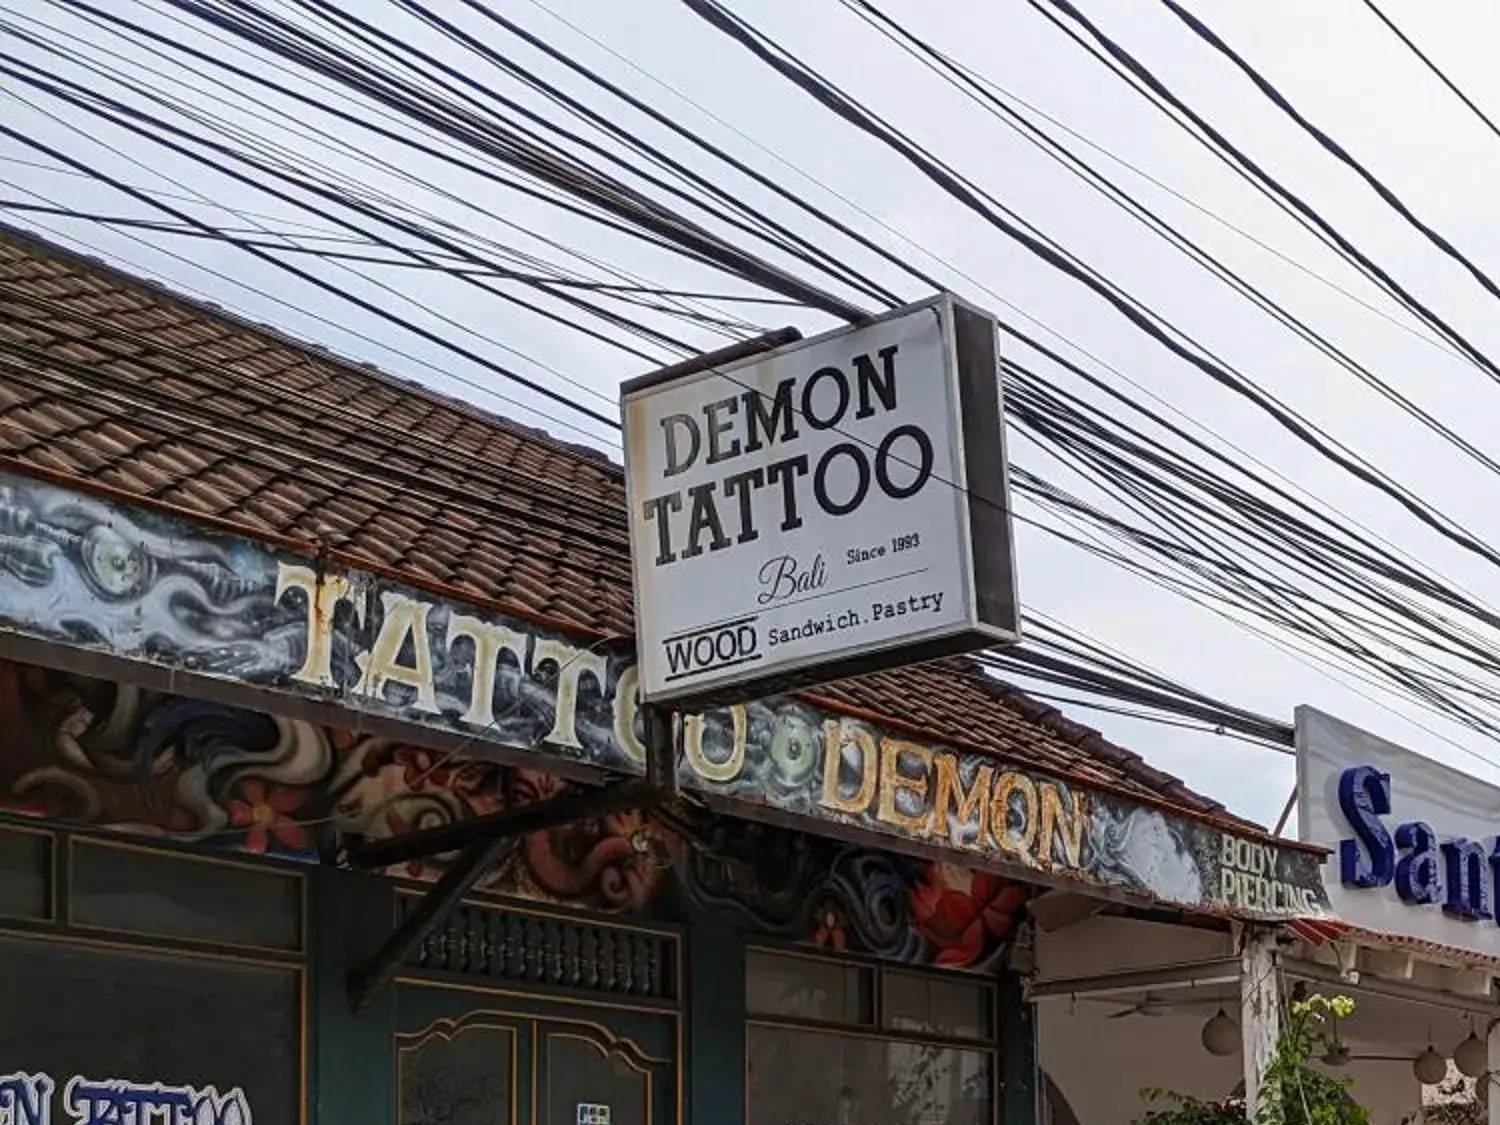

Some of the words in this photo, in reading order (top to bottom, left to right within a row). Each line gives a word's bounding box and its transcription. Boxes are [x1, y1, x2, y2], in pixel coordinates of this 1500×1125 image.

[660, 346, 899, 478] DEMON
[643, 424, 934, 567] TATTOO
[757, 554, 828, 605] Bali
[847, 545, 886, 565] Since
[665, 625, 757, 674] WOOD
[820, 719, 1084, 870] DEMON
[1220, 834, 1279, 879] BODY
[1220, 866, 1325, 917] PIERCING
